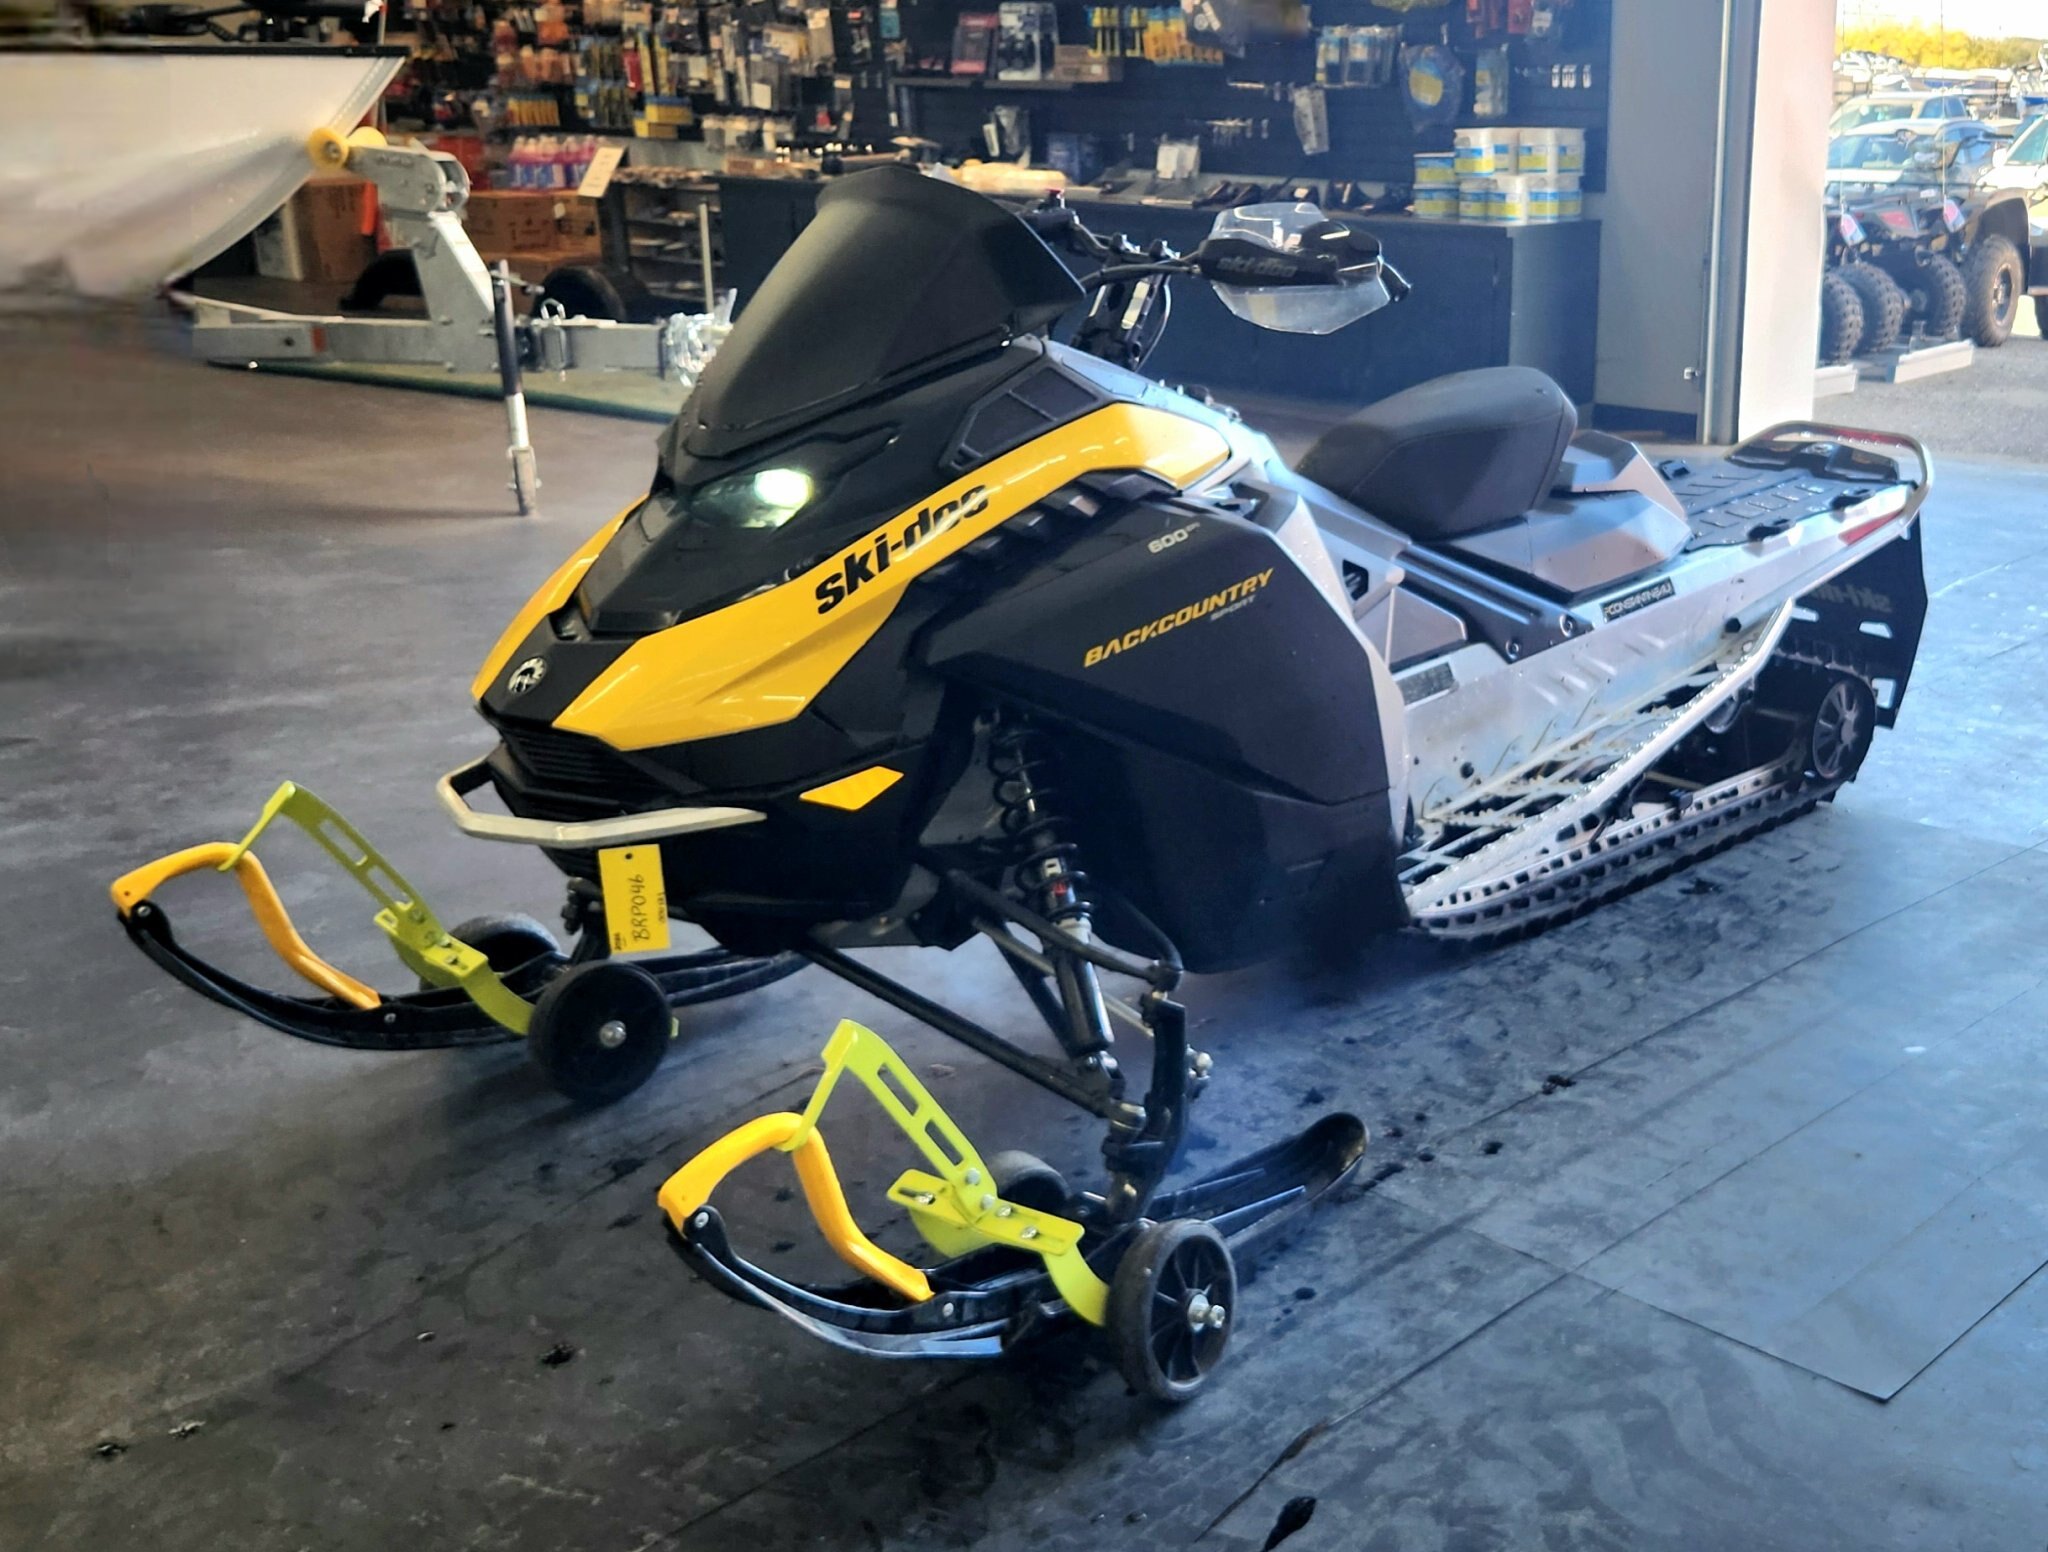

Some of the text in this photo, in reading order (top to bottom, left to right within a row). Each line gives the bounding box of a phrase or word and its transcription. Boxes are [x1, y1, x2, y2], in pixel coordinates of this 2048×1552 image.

[815, 484, 989, 615] ski-doo
[1147, 528, 1189, 554] 600
[1083, 567, 1274, 668] BACKCOUNTRY
[628, 873, 651, 942] BRP046
